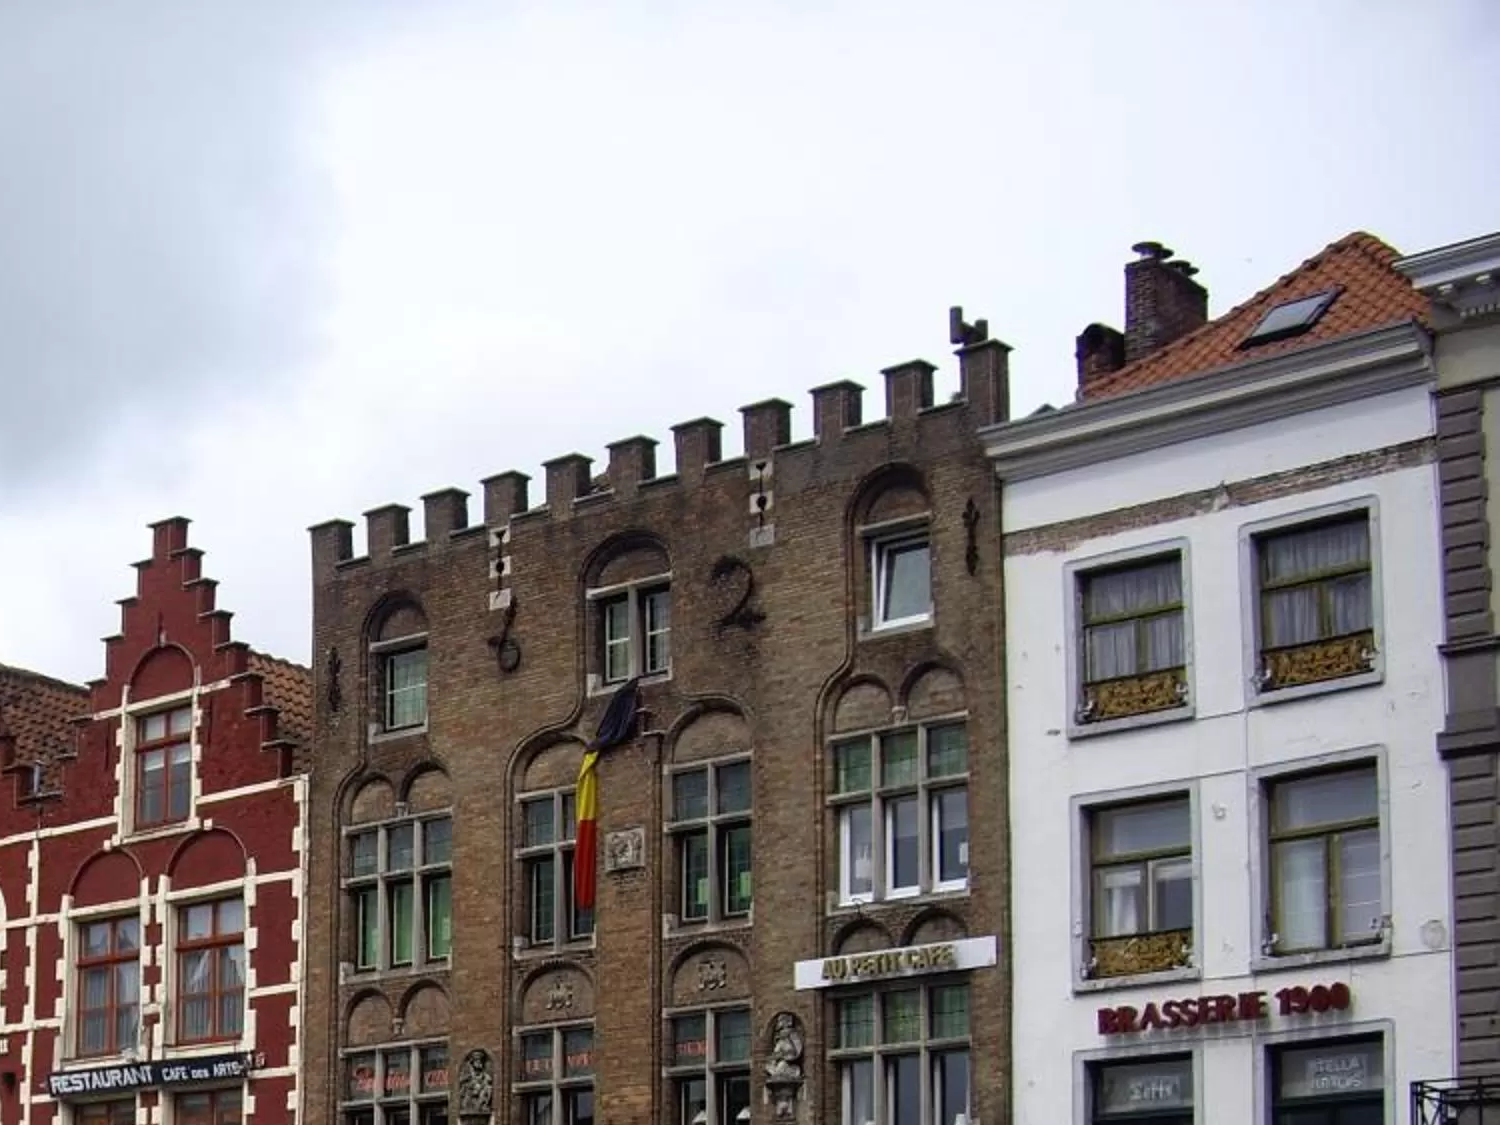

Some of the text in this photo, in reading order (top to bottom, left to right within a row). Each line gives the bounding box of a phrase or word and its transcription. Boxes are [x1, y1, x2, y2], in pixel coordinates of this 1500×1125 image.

[821, 957, 848, 981] AU
[1098, 982, 1351, 1034] BRASSERIE 1900
[50, 1064, 154, 1094] RESTAURANT
[212, 1061, 241, 1078] ARTS
